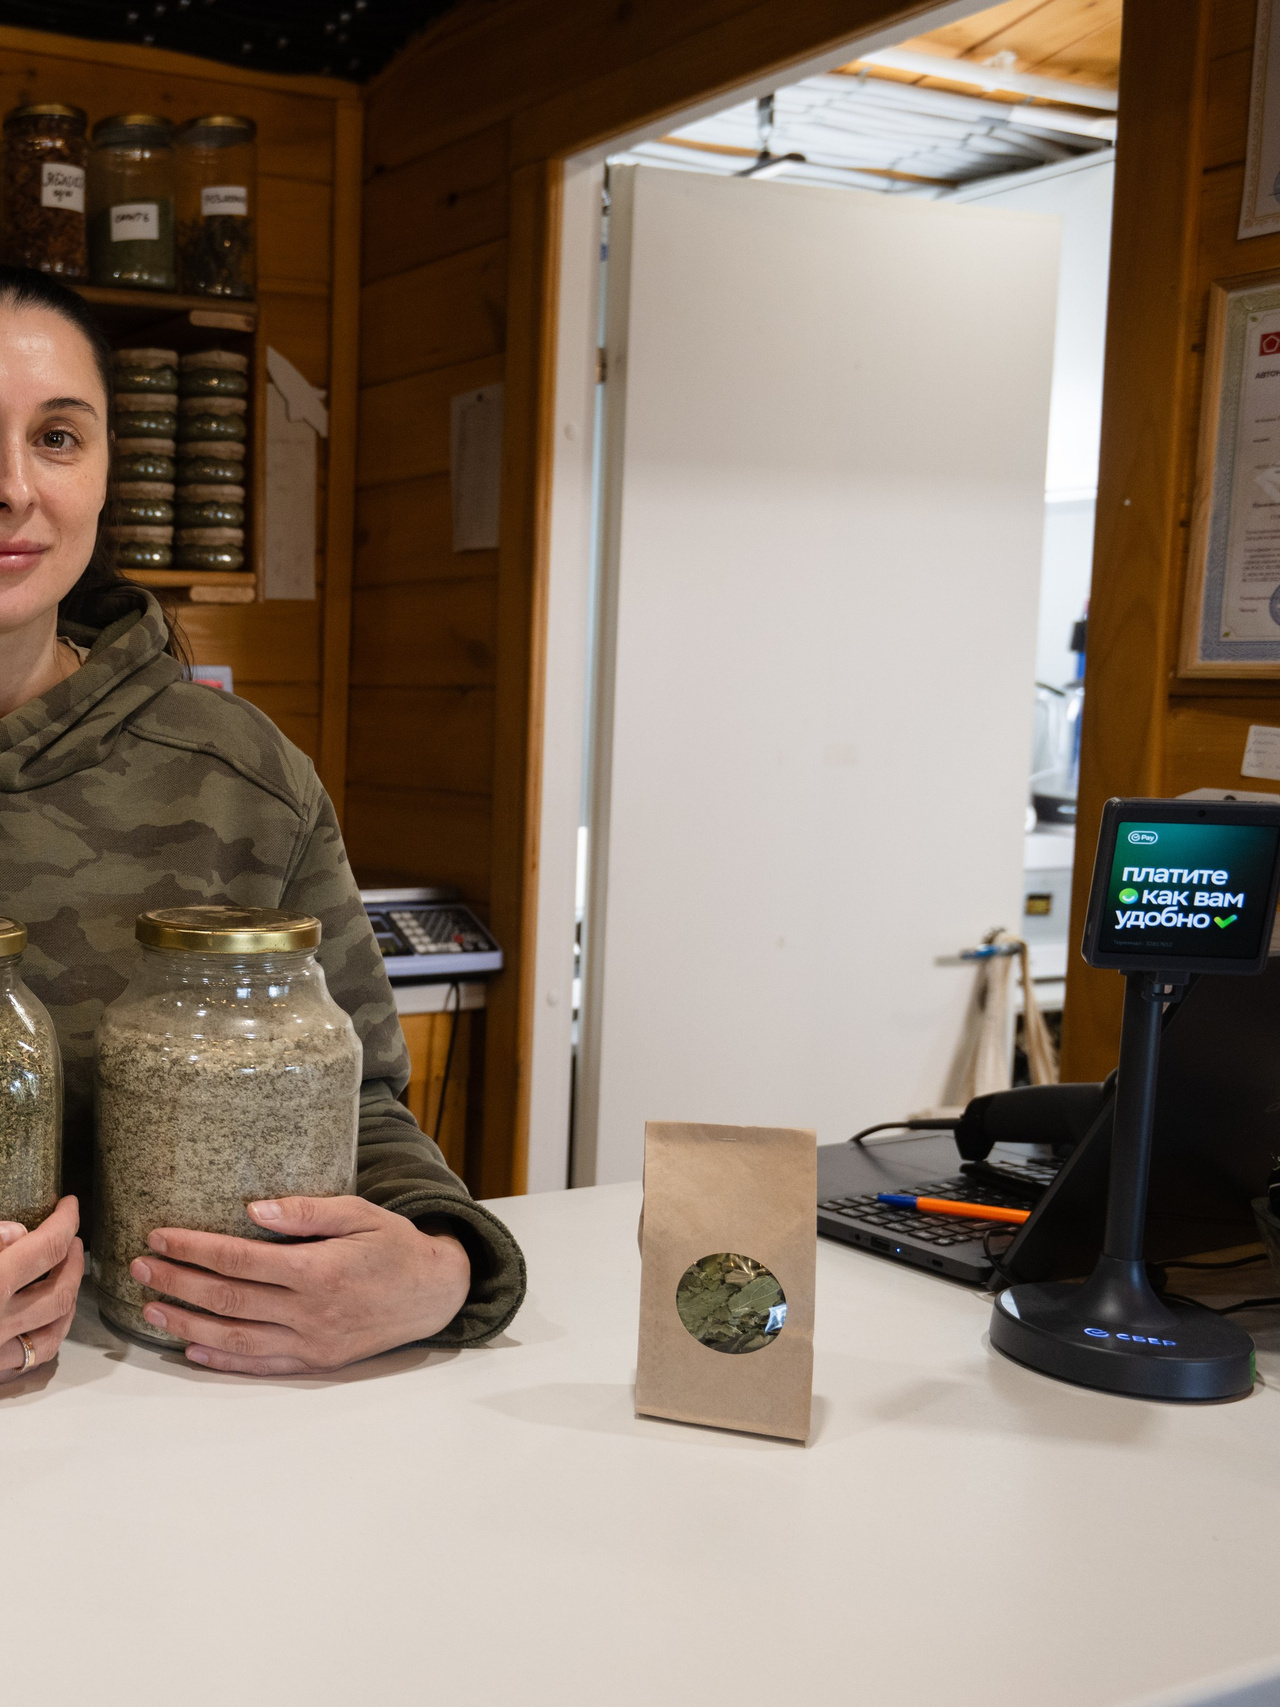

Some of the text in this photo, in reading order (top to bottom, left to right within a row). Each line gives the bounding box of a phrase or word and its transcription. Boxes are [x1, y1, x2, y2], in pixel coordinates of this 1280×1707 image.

[1141, 834, 1155, 842] Pay
[1122, 867, 1228, 885] платите
[1142, 889, 1245, 908] как вам
[1114, 907, 1211, 930] удобно
